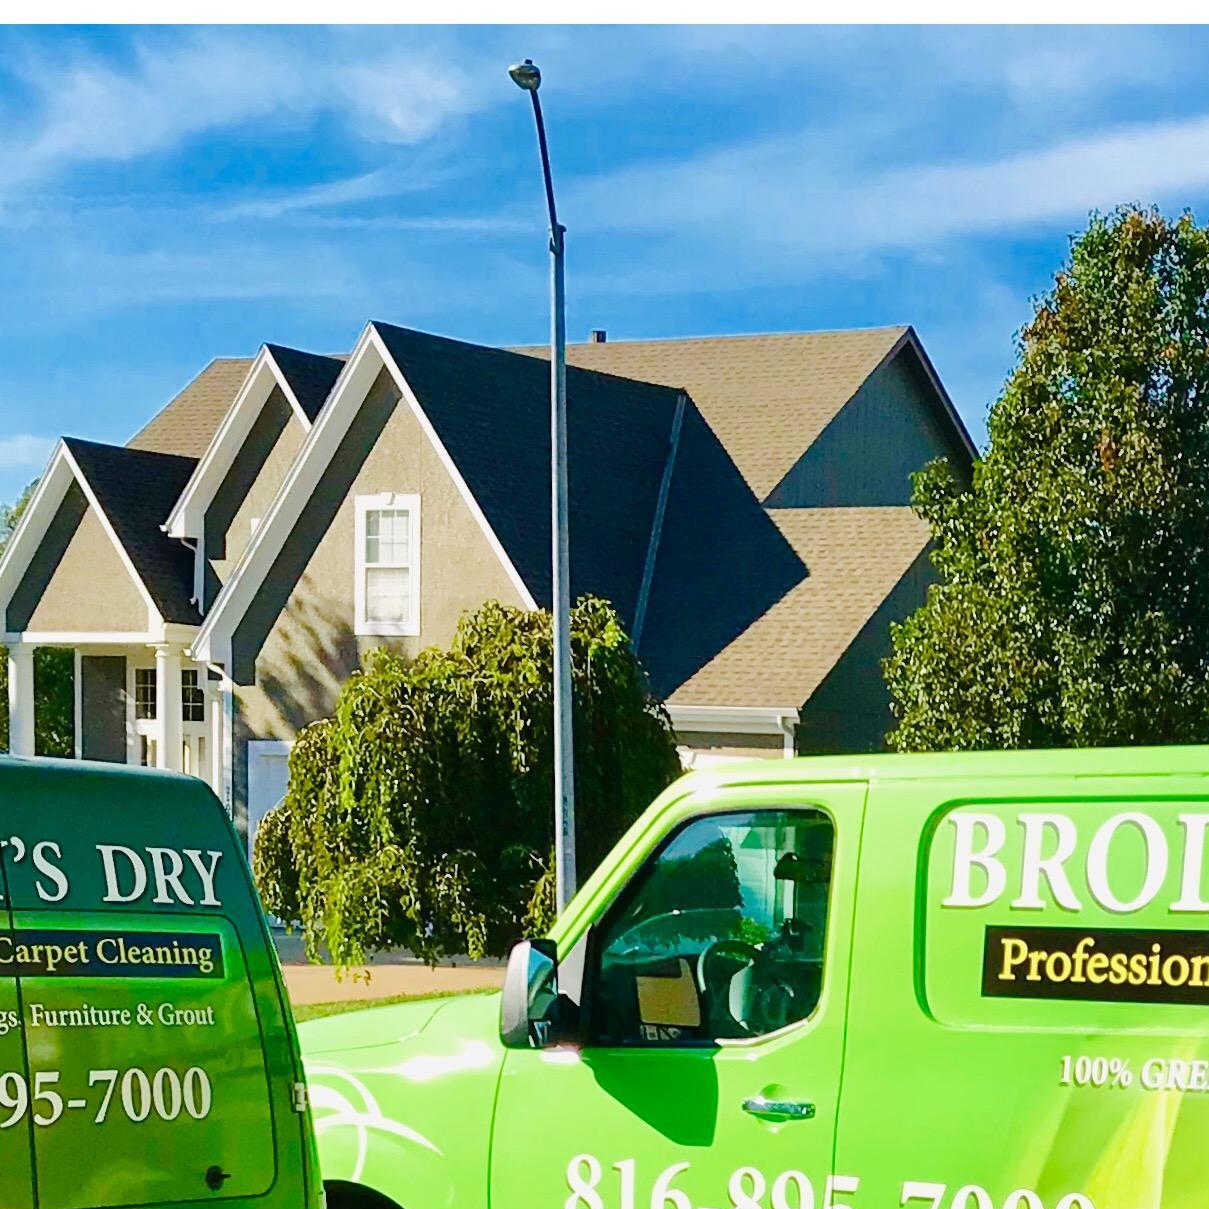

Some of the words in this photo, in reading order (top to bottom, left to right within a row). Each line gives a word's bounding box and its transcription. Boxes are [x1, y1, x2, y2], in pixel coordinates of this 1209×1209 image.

[0, 836, 69, 902] 'S
[96, 844, 222, 907] DRY
[0, 937, 88, 972] Carpet
[96, 939, 214, 973] Cleaning
[29, 1003, 131, 1027] Furniture
[137, 1006, 154, 1025] &
[158, 1003, 215, 1026] Grout
[1059, 1055, 1133, 1088] 100%
[0, 1066, 212, 1127] 95-7000
